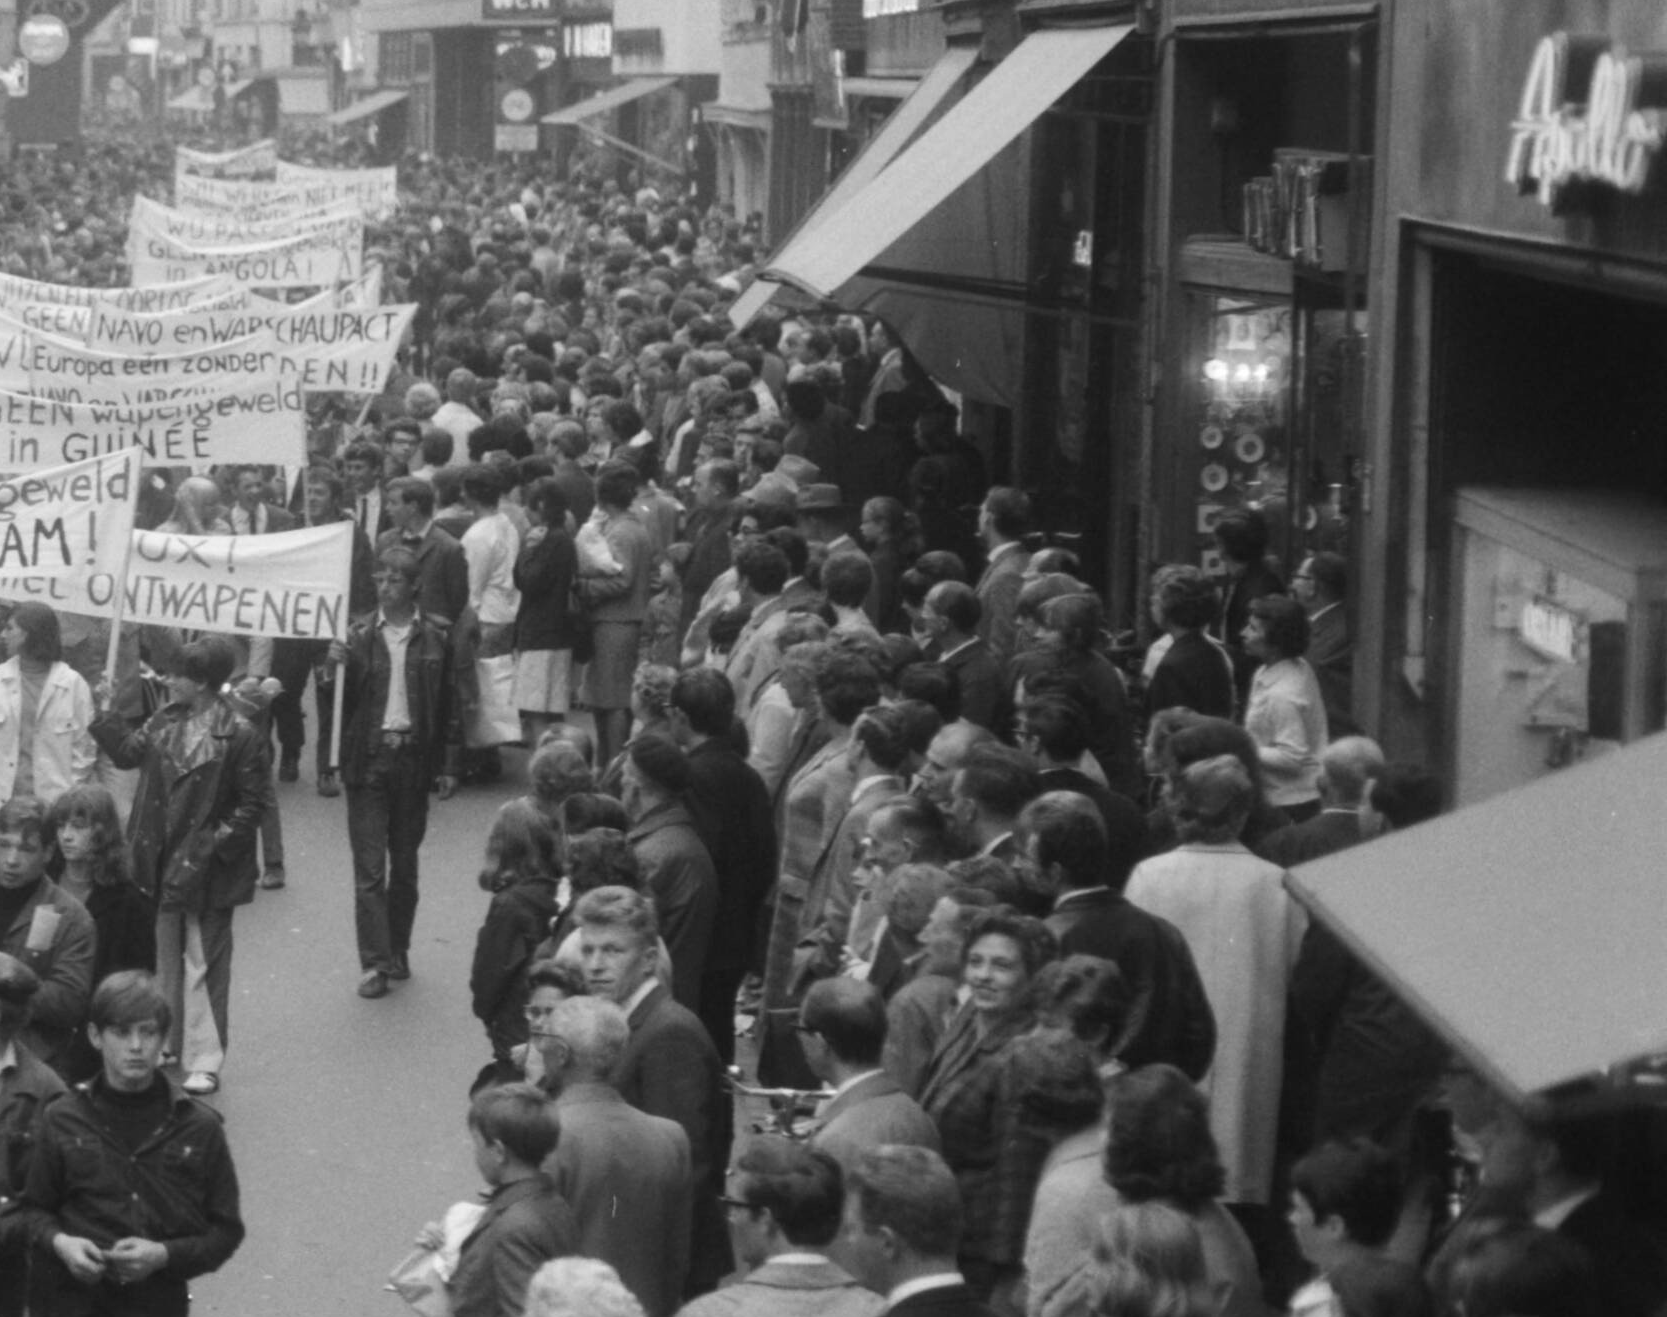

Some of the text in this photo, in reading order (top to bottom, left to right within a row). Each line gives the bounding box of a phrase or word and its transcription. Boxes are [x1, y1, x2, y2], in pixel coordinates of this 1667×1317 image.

[96, 313, 164, 346] NAVO
[173, 323, 208, 345] en
[33, 344, 116, 384] Europa
[9, 429, 40, 465] in
